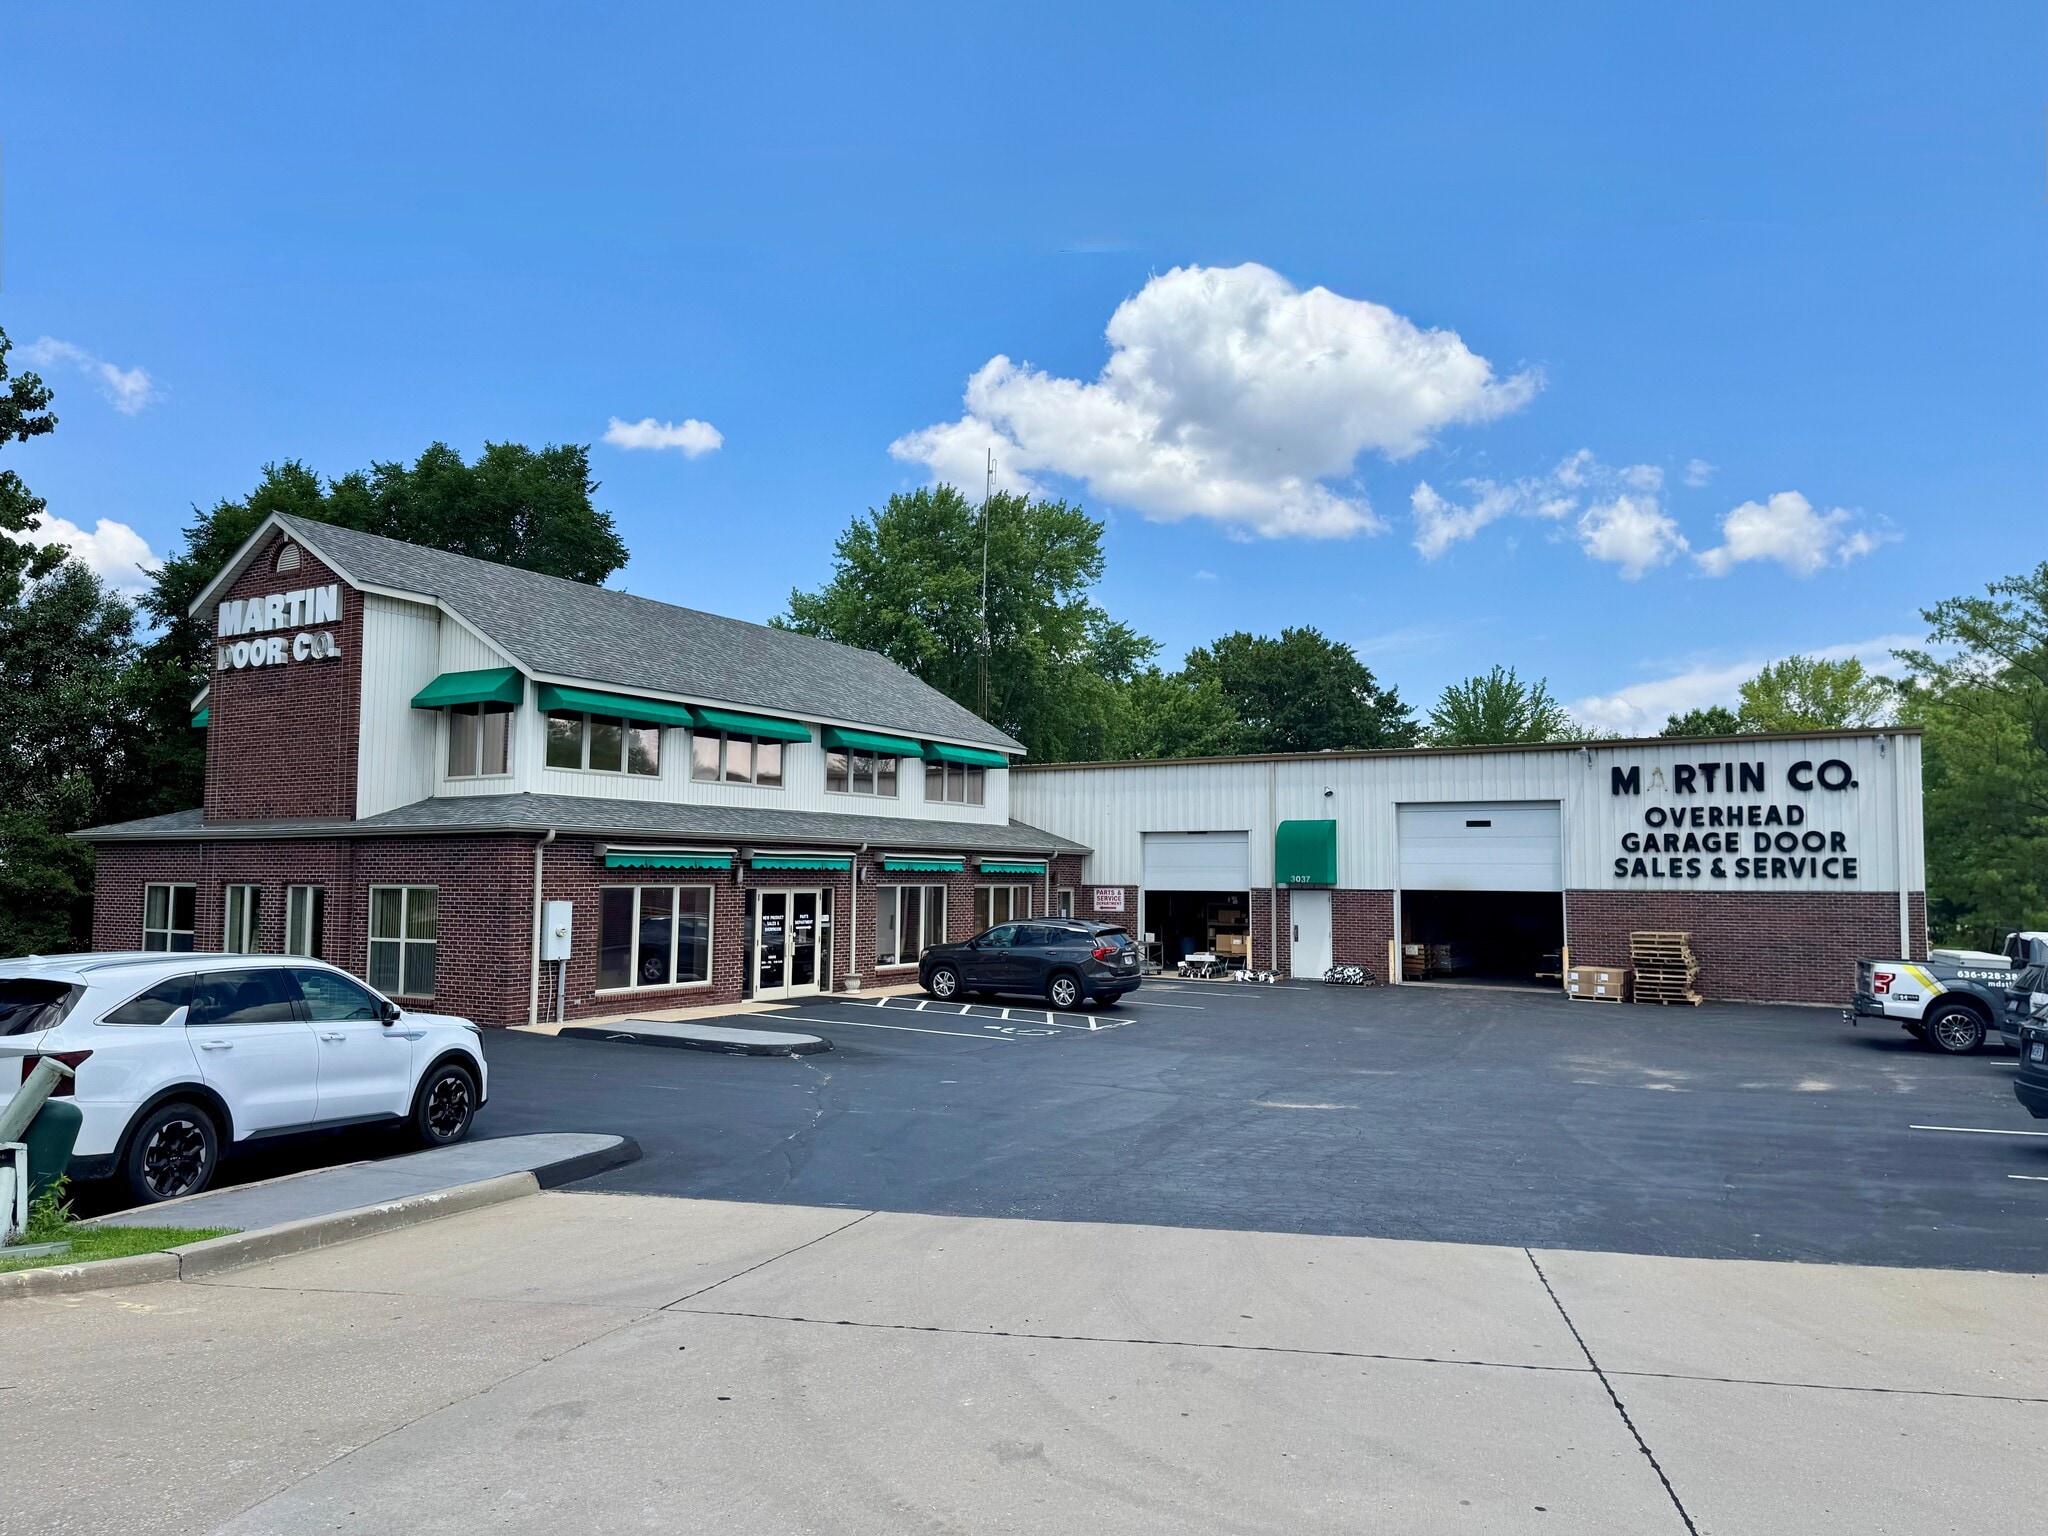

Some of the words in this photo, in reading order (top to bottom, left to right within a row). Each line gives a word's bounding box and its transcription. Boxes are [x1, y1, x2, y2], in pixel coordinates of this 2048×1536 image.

[218, 584, 343, 638] MARTIN
[293, 631, 341, 662] CO.
[1787, 759, 1858, 792] CO.
[1644, 804, 1804, 828] OVERHEAD
[1621, 832, 1739, 853] GARAGE
[1754, 830, 1847, 853] DOOR
[1290, 875, 1311, 883] 3037
[1614, 857, 1701, 879] SALES
[1710, 857, 1727, 878] &
[1734, 857, 1857, 879] SERVICE
